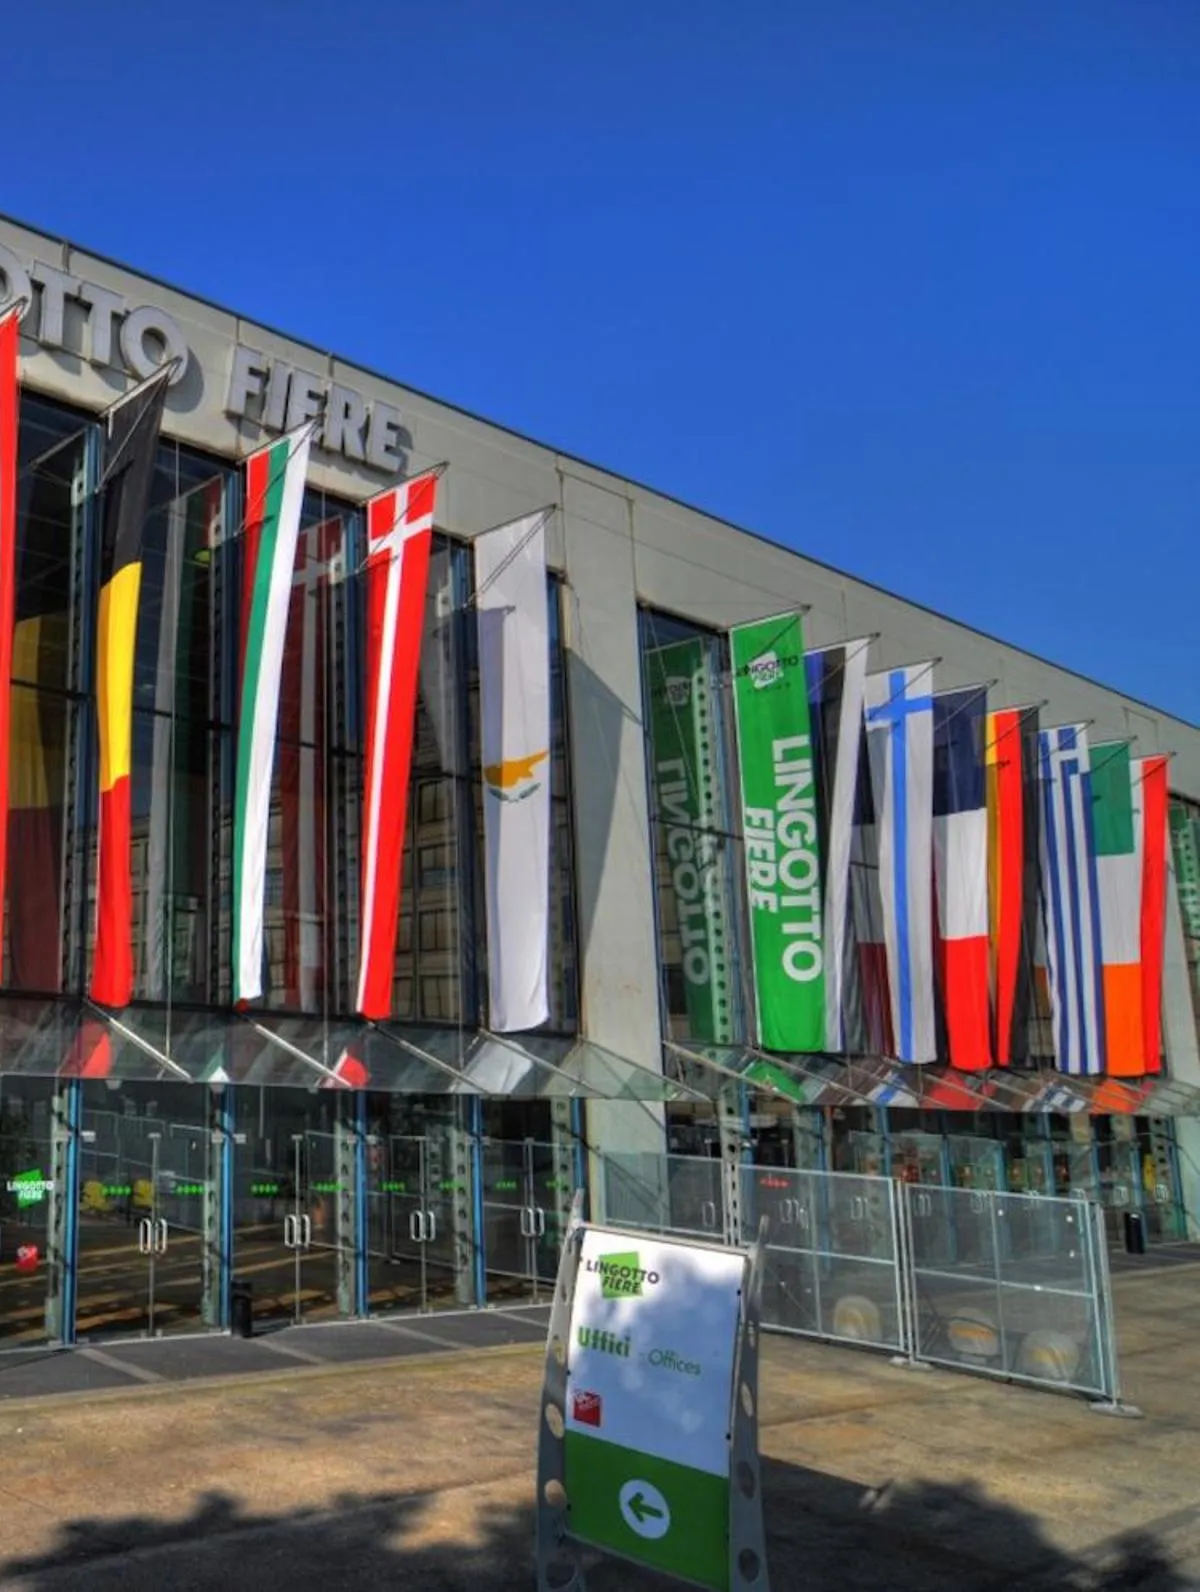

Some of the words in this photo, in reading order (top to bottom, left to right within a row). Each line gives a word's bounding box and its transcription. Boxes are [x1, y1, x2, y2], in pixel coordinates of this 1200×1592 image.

[224, 344, 405, 474] FIERE
[744, 806, 778, 914] FIERE
[771, 735, 824, 982] LINGOTTO
[586, 1260, 660, 1284] LINGOTTO
[602, 1276, 642, 1294] FIERE
[577, 1326, 630, 1358] Uffici
[648, 1348, 701, 1376] Offices
